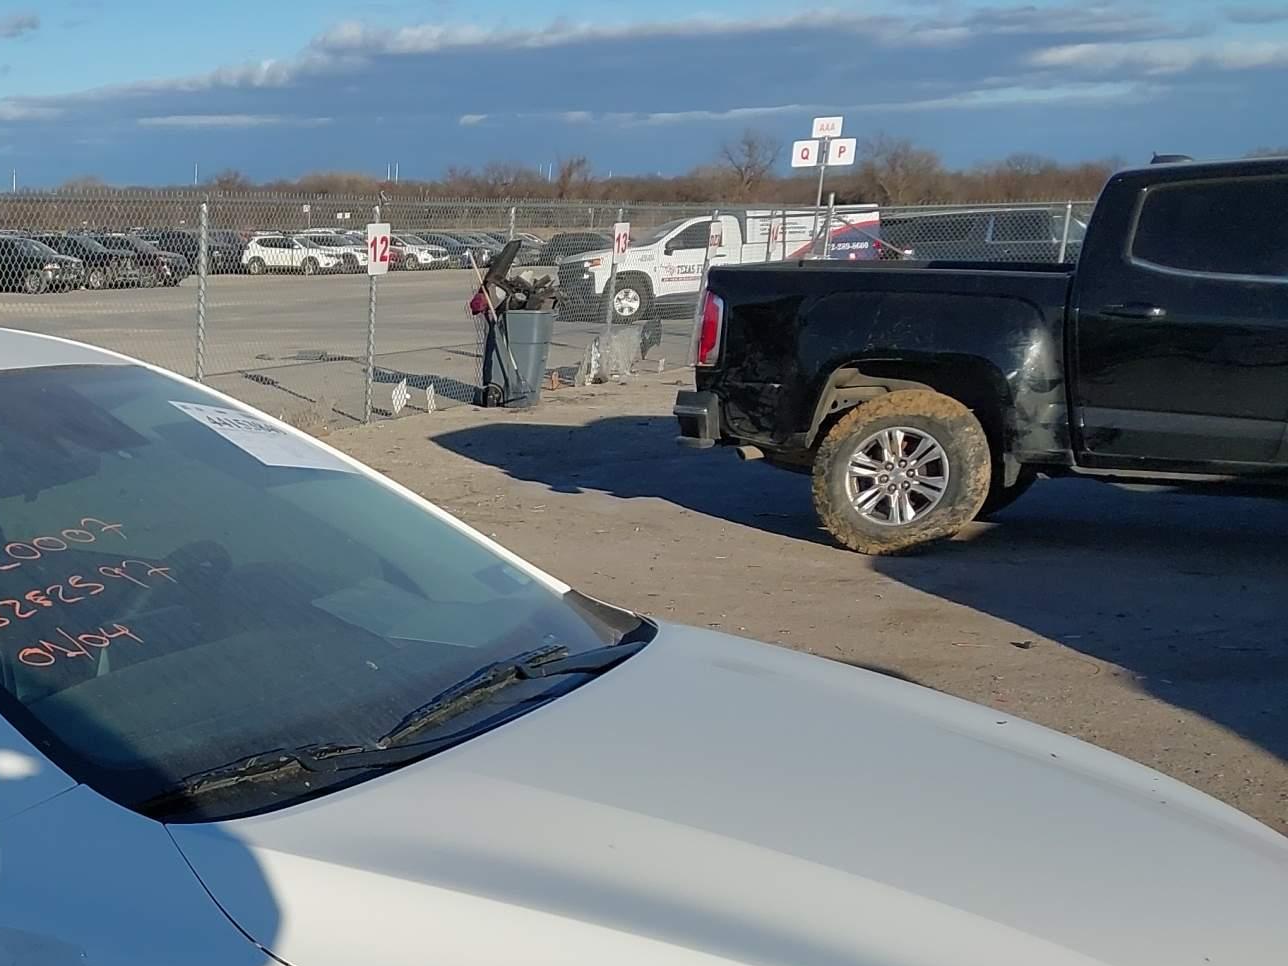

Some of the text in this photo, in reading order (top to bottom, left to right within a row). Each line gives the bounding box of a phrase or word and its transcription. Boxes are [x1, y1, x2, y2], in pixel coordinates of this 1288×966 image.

[800, 147, 810, 161] Q
[838, 145, 847, 159] P
[370, 236, 389, 263] 12
[616, 232, 628, 254] 13
[676, 263, 698, 275] TEXAS
